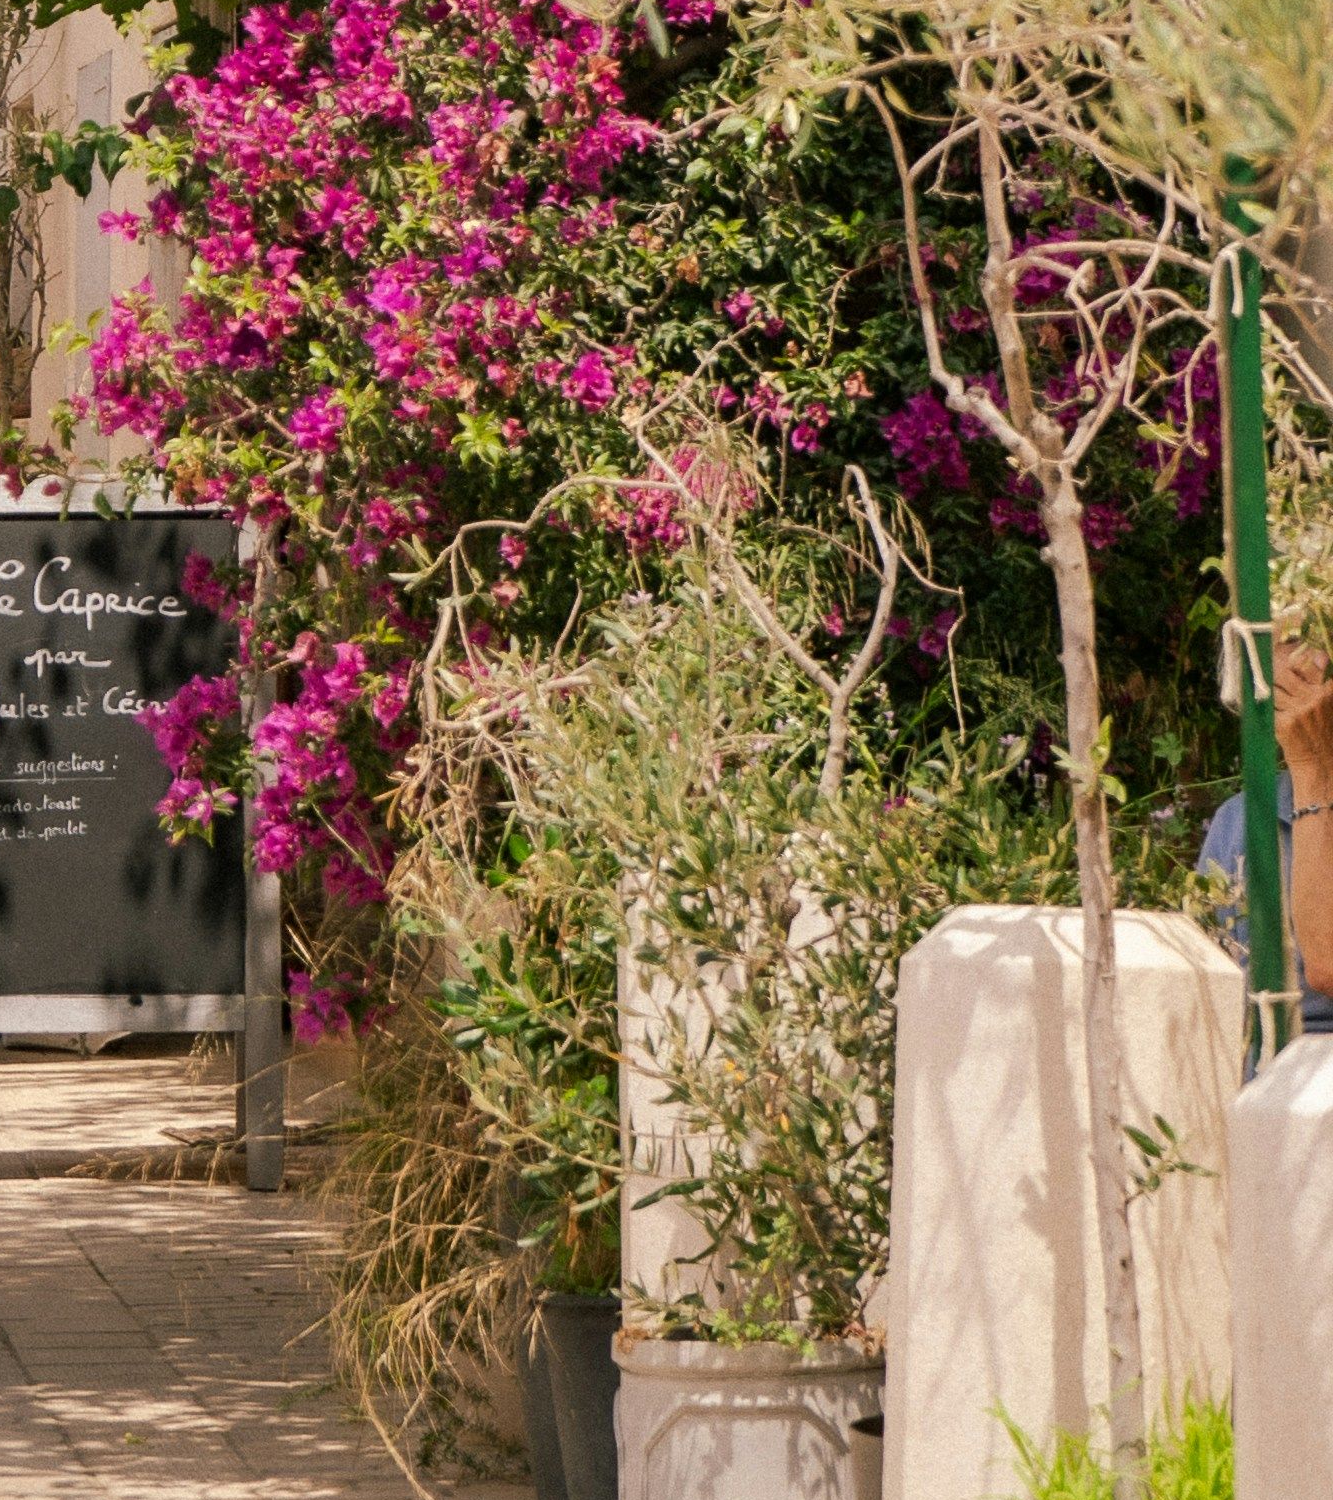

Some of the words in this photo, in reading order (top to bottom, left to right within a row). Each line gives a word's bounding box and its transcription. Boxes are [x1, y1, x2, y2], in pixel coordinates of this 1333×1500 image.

[34, 556, 187, 631] Caprice
[24, 648, 112, 678] par
[63, 696, 89, 716] et
